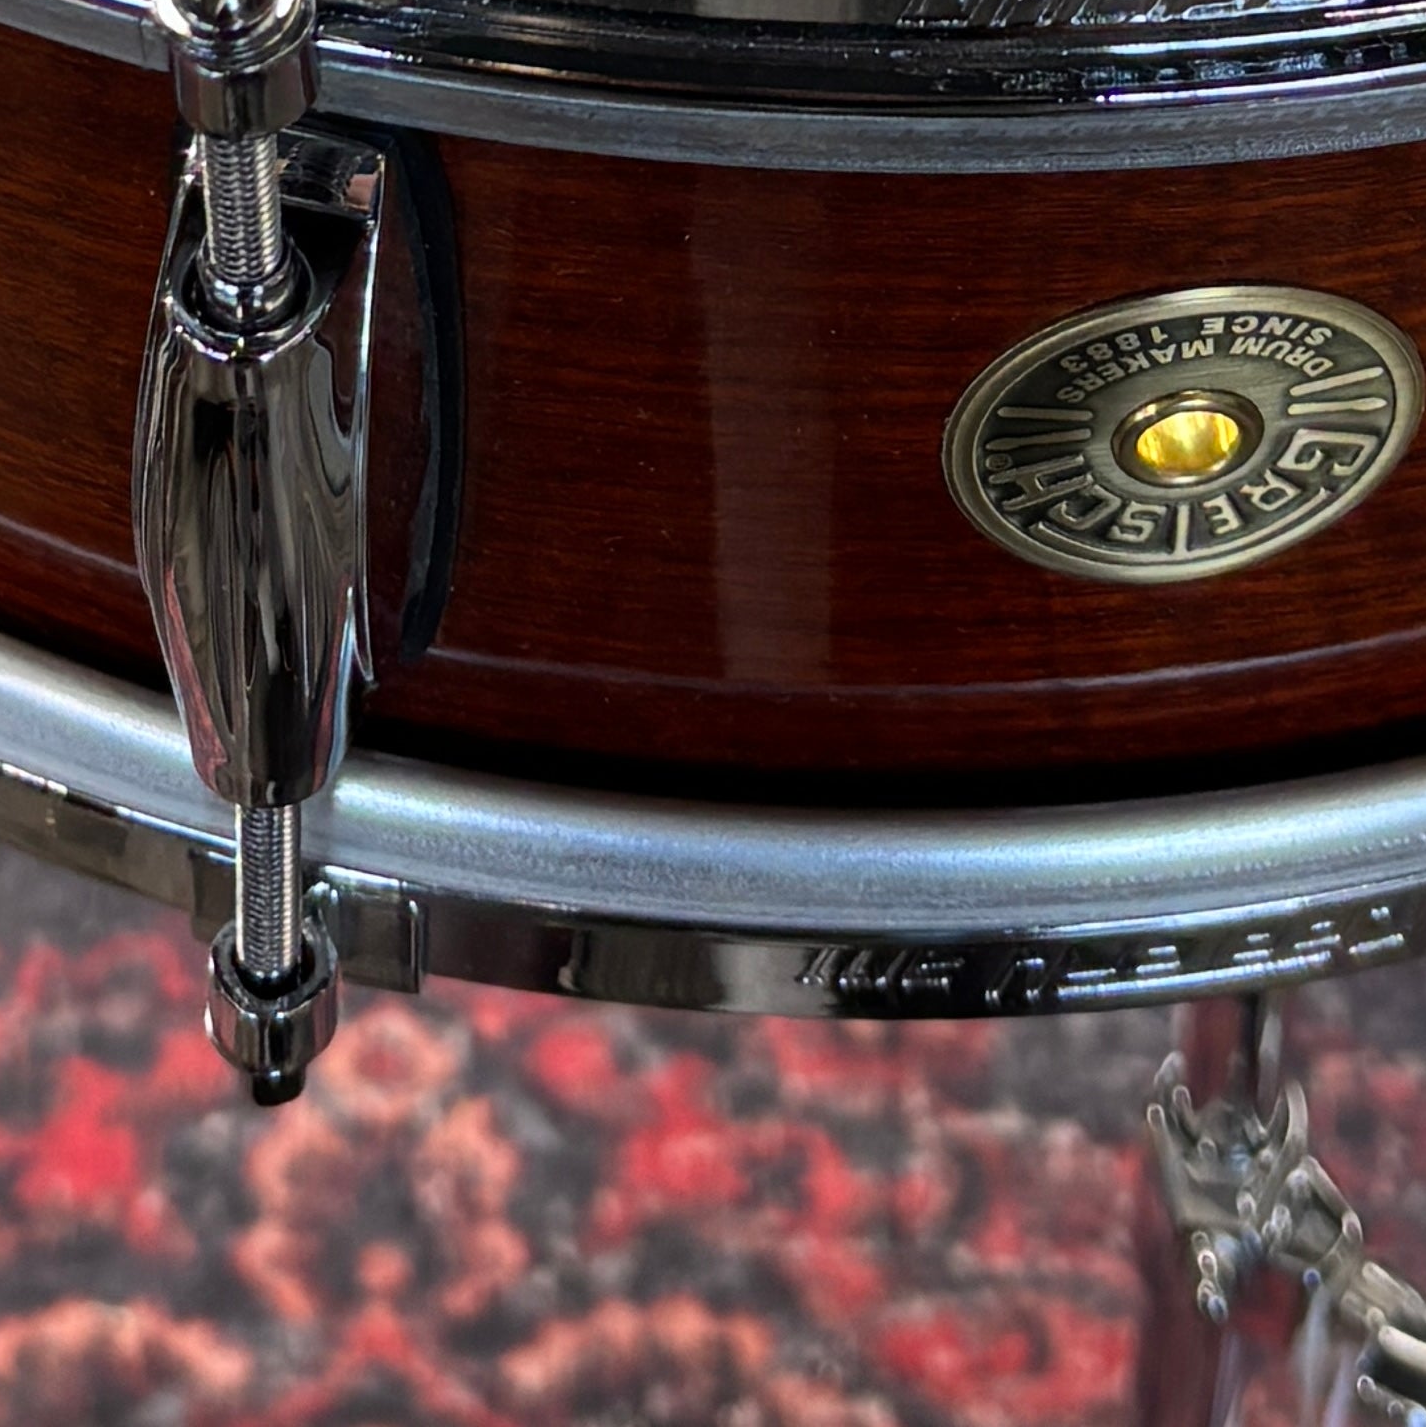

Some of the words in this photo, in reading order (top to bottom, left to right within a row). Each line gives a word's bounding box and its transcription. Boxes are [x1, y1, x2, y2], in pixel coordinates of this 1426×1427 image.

[1059, 325, 1172, 375] 1883
[1201, 315, 1333, 347] SINCE
[1056, 336, 1216, 405] MAKERS
[1229, 336, 1334, 379] DRUM
